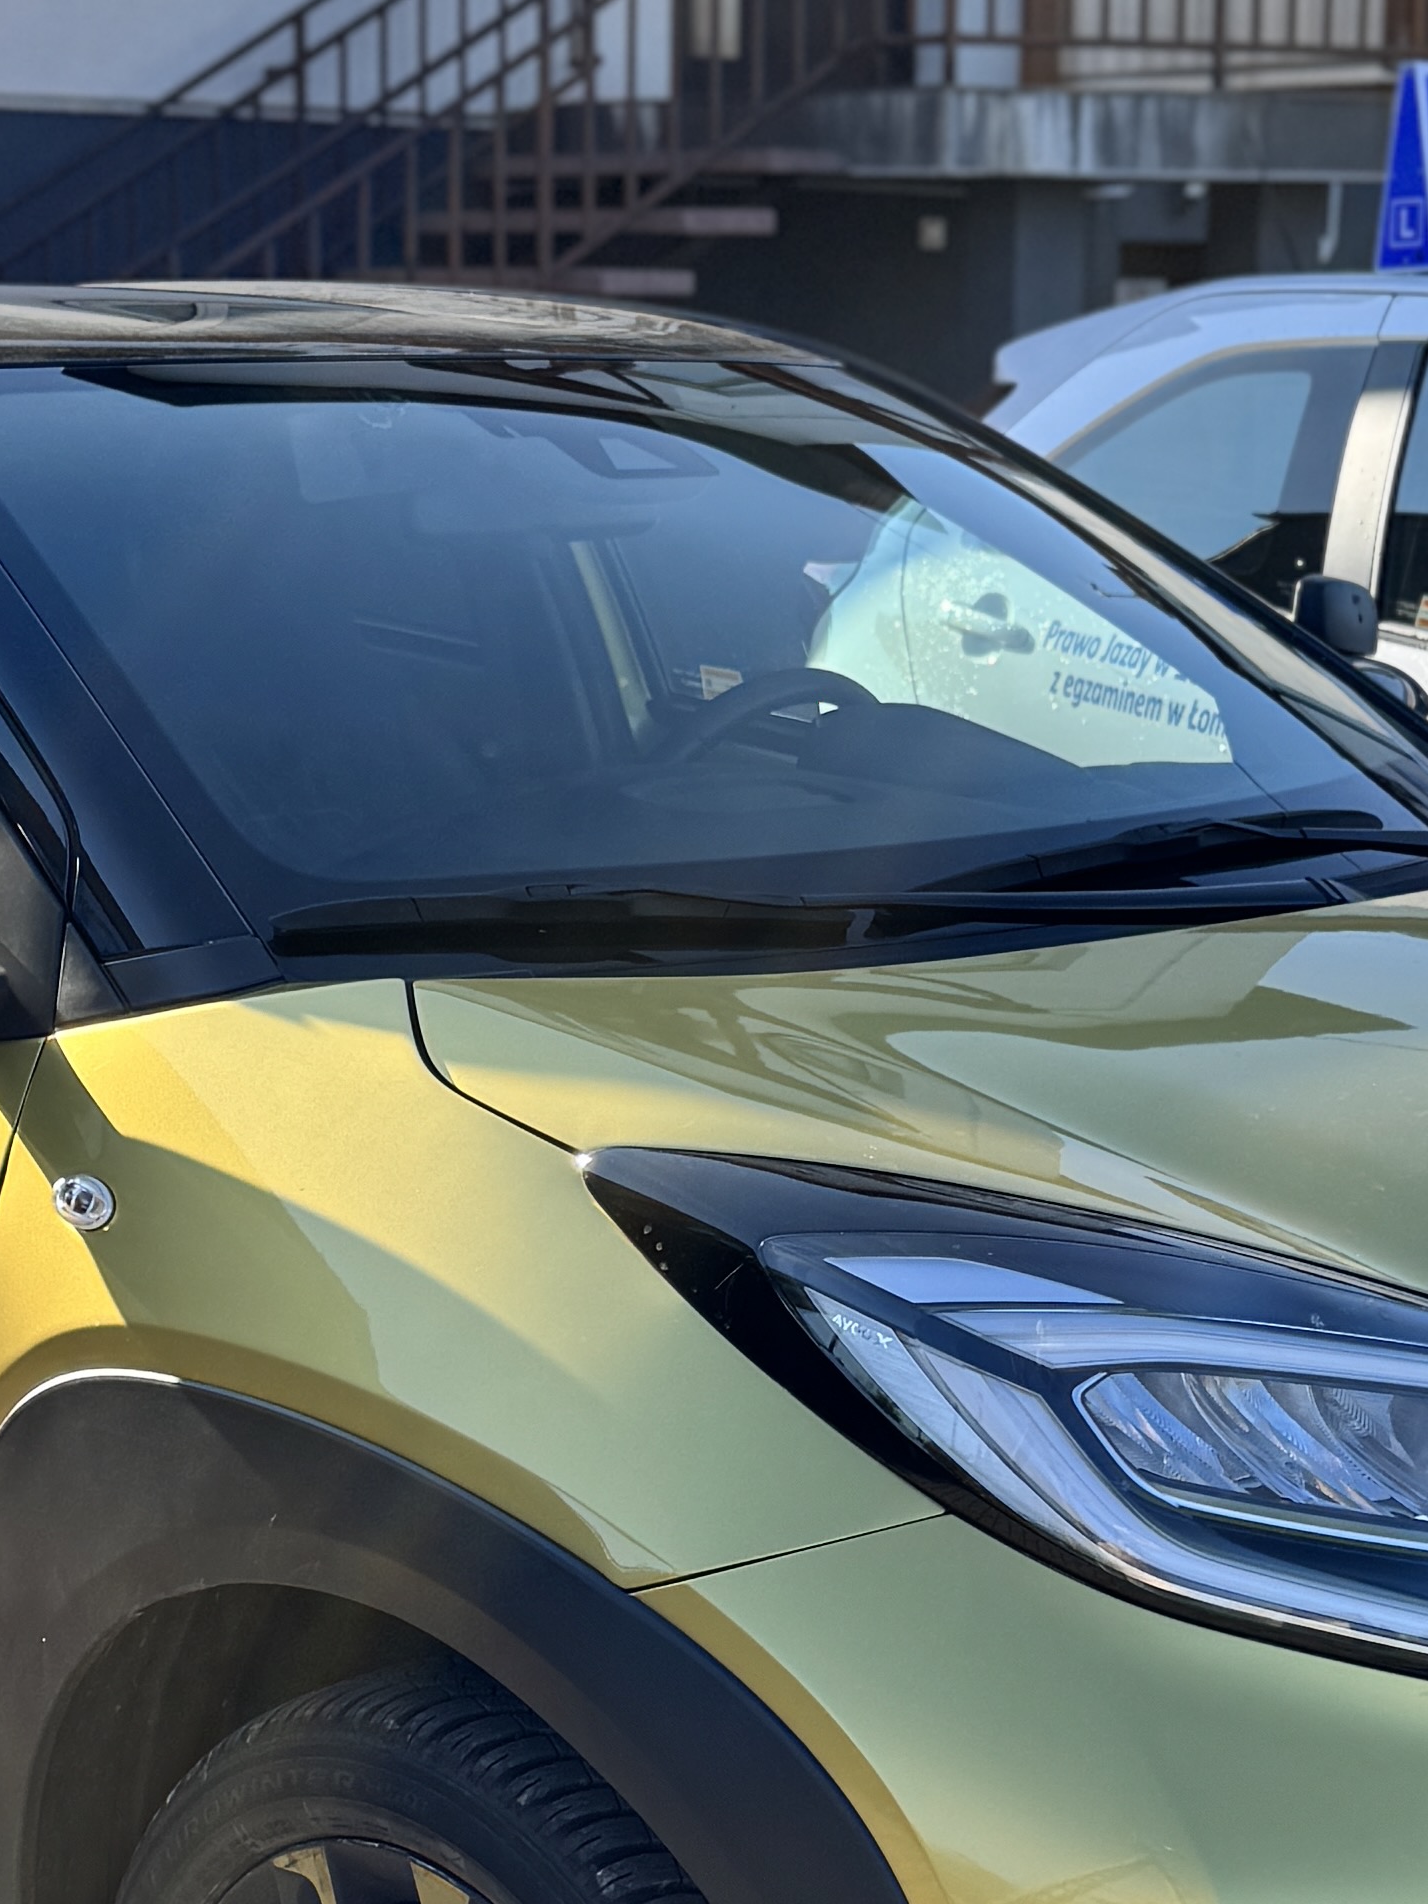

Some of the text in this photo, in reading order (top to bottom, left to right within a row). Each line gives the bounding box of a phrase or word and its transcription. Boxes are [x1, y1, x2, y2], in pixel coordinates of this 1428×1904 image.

[1043, 619, 1101, 659] Prawo
[1049, 670, 1061, 695] z
[1063, 674, 1164, 722] egzaminem
[1167, 699, 1186, 727] w
